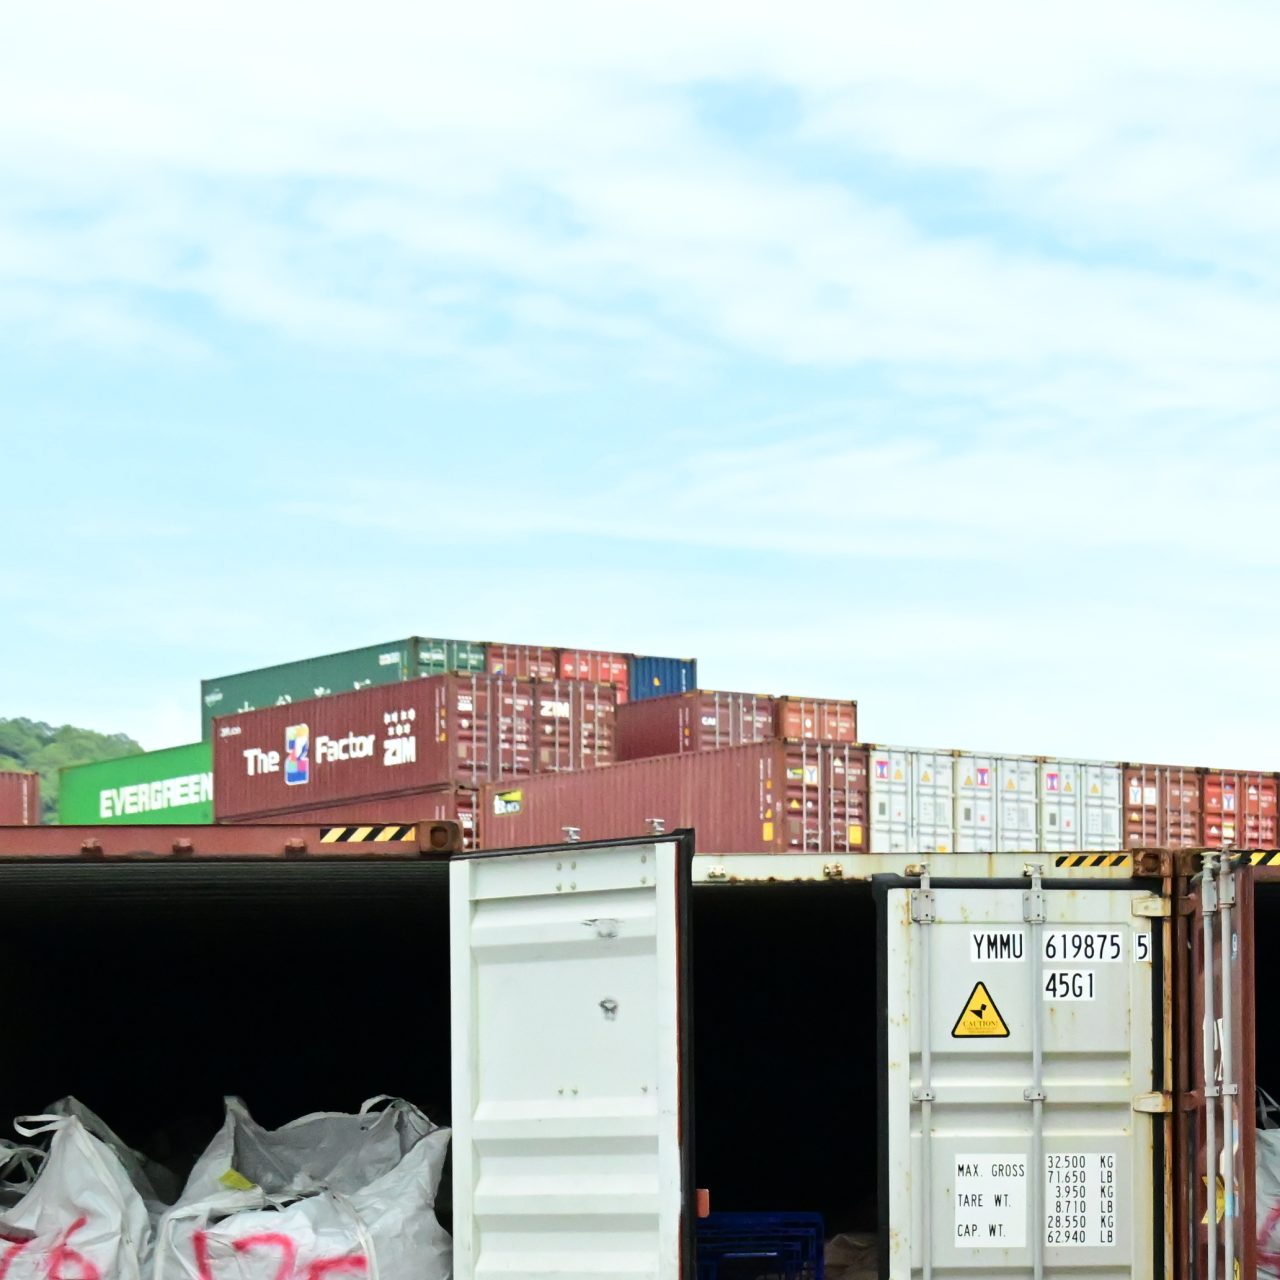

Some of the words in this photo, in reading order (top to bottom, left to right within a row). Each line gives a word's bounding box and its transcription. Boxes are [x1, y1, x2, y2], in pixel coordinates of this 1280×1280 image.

[243, 747, 280, 777] The
[315, 731, 376, 765] Factor
[383, 735, 417, 767] ZIM
[99, 771, 214, 819] EVERGREEN
[973, 933, 1023, 960] YMMU
[1045, 933, 1121, 960] 619875
[1137, 934, 1148, 960] 5
[1045, 972, 1094, 998] 45G1
[1047, 1155, 1086, 1168] 32.500
[1100, 1155, 1114, 1168] KG
[957, 1164, 983, 1177] MAX.
[991, 1164, 1025, 1177] GROSS
[1047, 1170, 1086, 1183] 71.650
[1100, 1170, 1113, 1183] LB
[1055, 1185, 1086, 1198] 3.950
[1100, 1185, 1114, 1198] KG
[958, 1194, 984, 1207] TARE
[994, 1194, 1011, 1207] WT.
[1055, 1200, 1086, 1213] 8.710
[1100, 1200, 1113, 1213] LB
[1047, 1215, 1086, 1228] 28.550
[1100, 1215, 1114, 1228] KG
[957, 1224, 980, 1237] CAP.
[989, 1224, 1006, 1237] WT.
[1047, 1230, 1086, 1243] 62.940
[1100, 1230, 1113, 1243] LB
